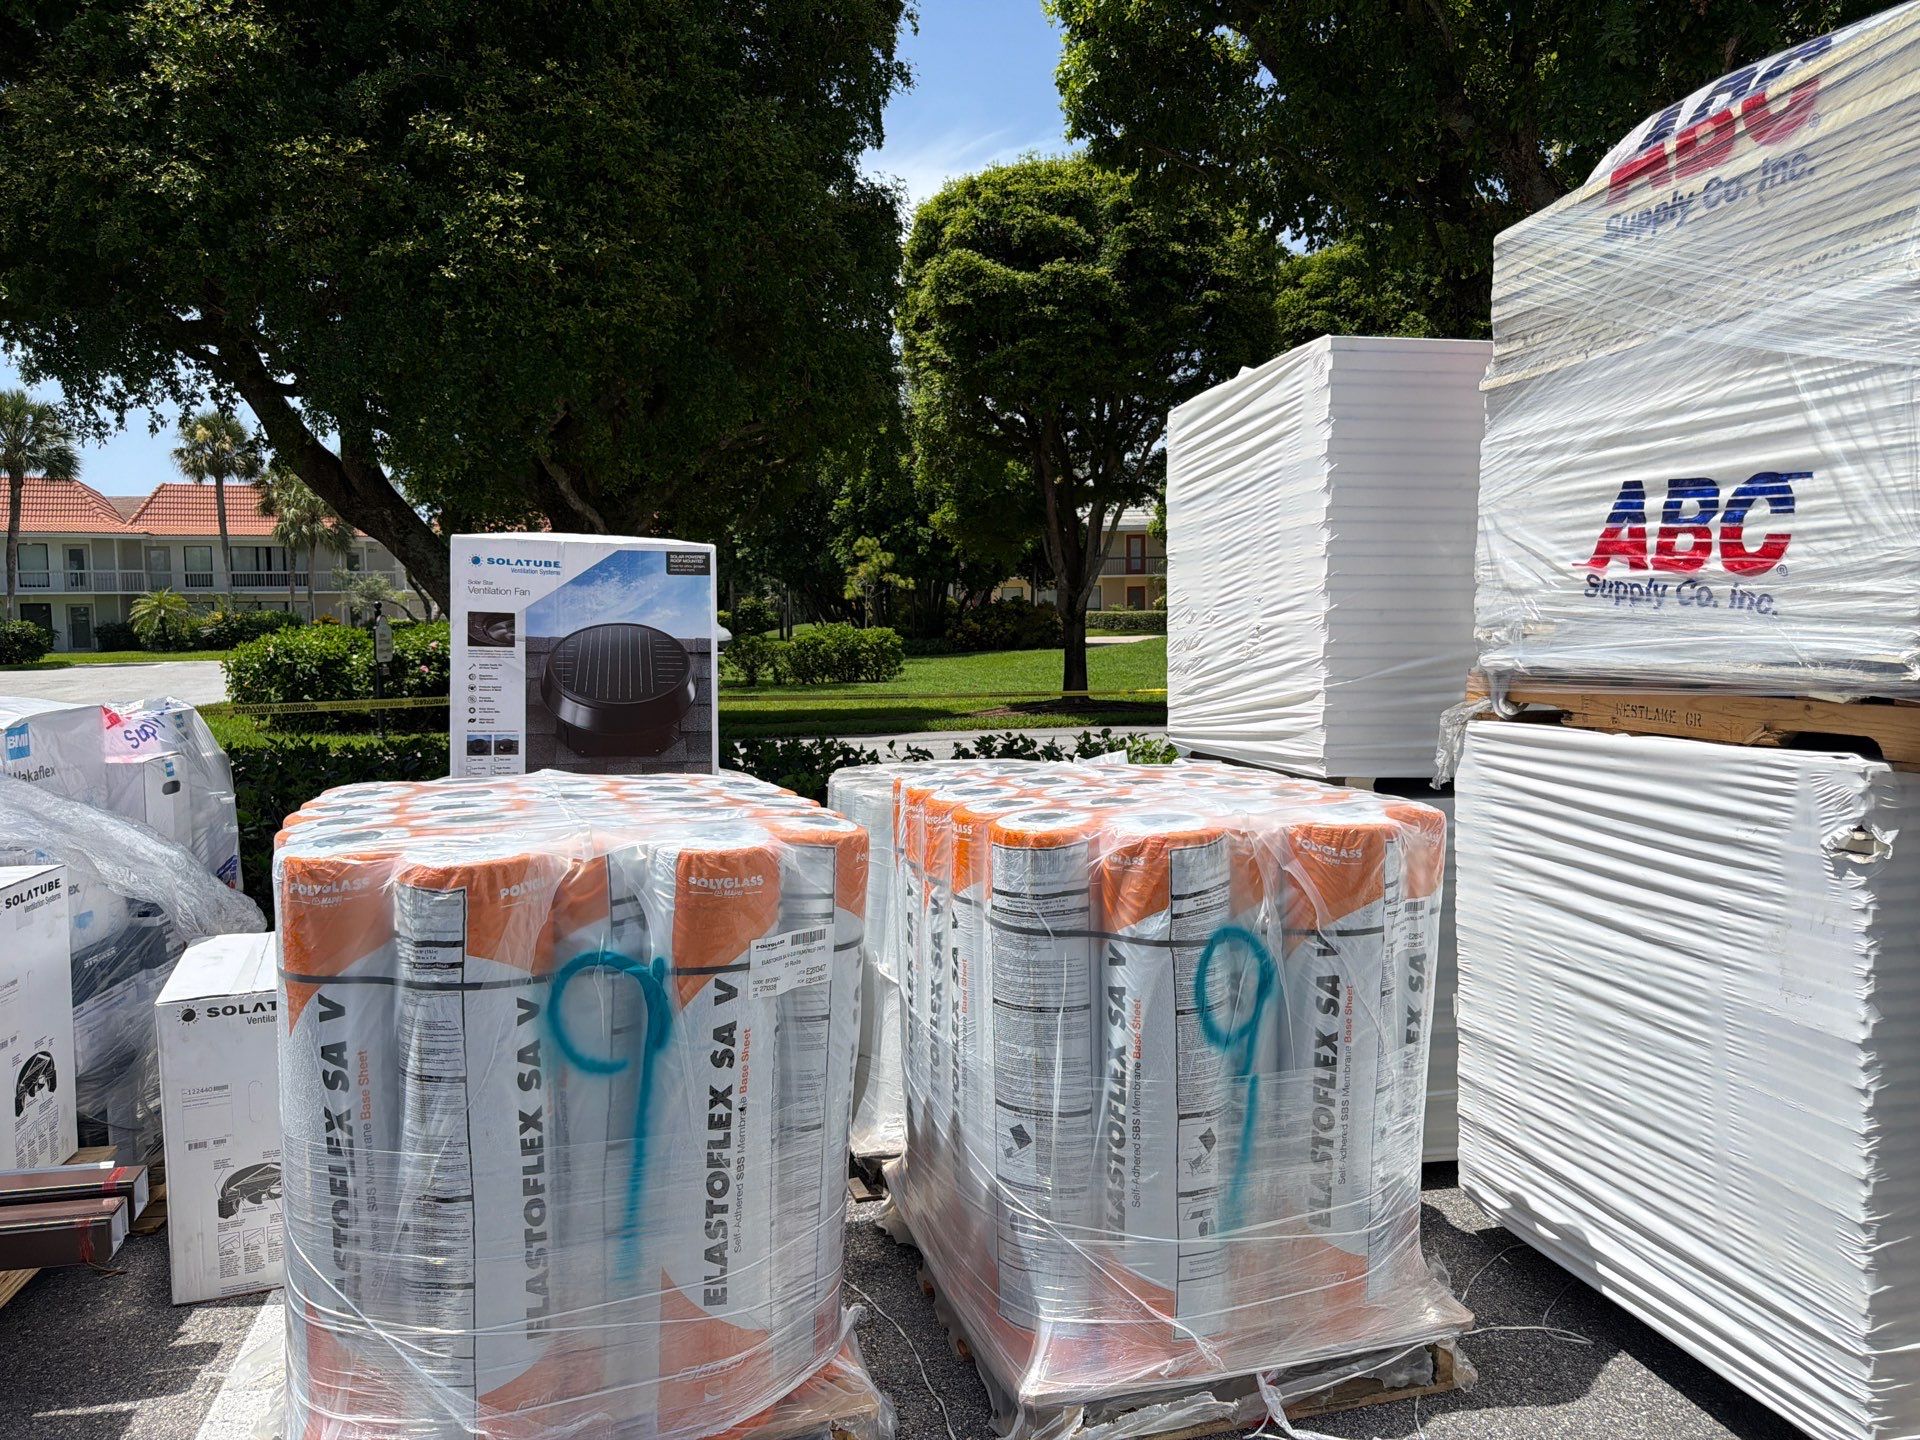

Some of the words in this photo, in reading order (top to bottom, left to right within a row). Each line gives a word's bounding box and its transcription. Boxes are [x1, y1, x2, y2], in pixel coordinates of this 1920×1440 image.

[1608, 37, 1833, 206] ABC
[1702, 176, 1748, 210] Co.
[1572, 471, 1814, 577] ABC
[486, 557, 561, 569] SOLATUBE
[511, 567, 538, 575] Ventilation
[539, 568, 561, 576] Systems
[467, 586, 512, 596] Ventilation
[514, 587, 531, 597] Fan
[1583, 573, 1669, 609] Supply
[1675, 579, 1719, 608] Co.
[1728, 582, 1779, 616] inc.
[5, 878, 61, 910] SOLATUBE
[289, 878, 371, 897] POLYGLASS
[688, 874, 765, 890] POLYGLASS
[951, 947, 959, 988] SA
[1108, 943, 1127, 967] V
[960, 959, 968, 988] Sheet
[1408, 952, 1427, 994] SA
[317, 993, 347, 1022] V
[713, 977, 739, 1006] V
[961, 990, 969, 1014] Base
[1315, 974, 1341, 1018] SA
[1344, 985, 1354, 1017] Sheet
[206, 1001, 277, 1018] SOLAT
[246, 1014, 277, 1025] Ventilat
[516, 996, 541, 1026] V
[1107, 985, 1128, 1031] SA
[1132, 999, 1142, 1031] Sheet
[710, 1020, 738, 1070] SA
[741, 1028, 752, 1063] Sheet
[1132, 1033, 1142, 1060] Base
[1343, 1018, 1354, 1044] Base
[321, 1041, 350, 1093] SA
[357, 1049, 371, 1086] Sheet
[516, 1038, 542, 1092] SA
[739, 1064, 749, 1095] Base
[1342, 1045, 1353, 1098] Membrane
[359, 1090, 372, 1120] Base
[1132, 1062, 1142, 1116] Membrane
[1340, 1099, 1351, 1122] SBS
[1132, 1118, 1142, 1141] SBS
[1307, 1027, 1338, 1229] ELASTOFLEX
[736, 1155, 747, 1181] SBS
[1337, 1124, 1349, 1185] Self-Adhered
[1131, 1143, 1142, 1208] Self-Adhered
[702, 1083, 733, 1307] ELASTOFLEX
[517, 1105, 550, 1340] ELASTOFLEX
[733, 1182, 746, 1253] Self-Adhered
